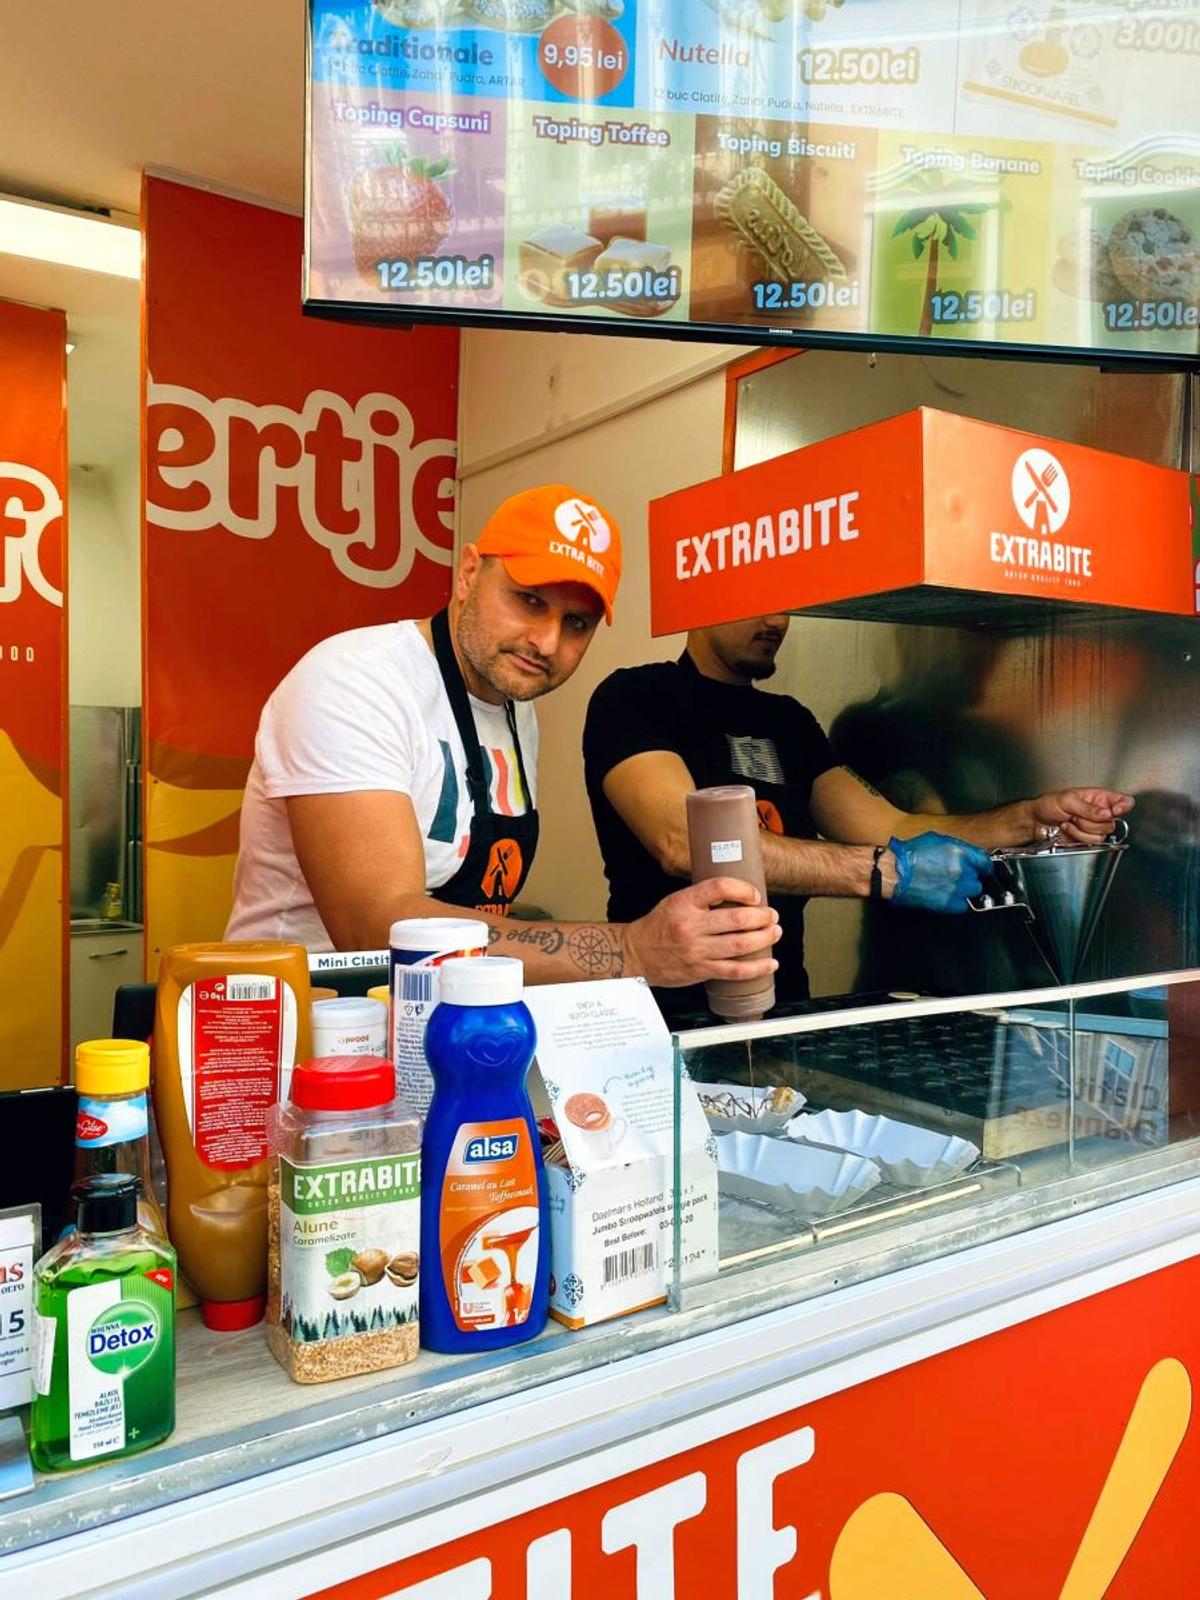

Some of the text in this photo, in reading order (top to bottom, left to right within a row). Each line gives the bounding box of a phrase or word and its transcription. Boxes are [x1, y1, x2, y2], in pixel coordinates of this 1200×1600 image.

[331, 34, 493, 66] Traditionale
[544, 43, 624, 71] 9,95 lei
[659, 39, 750, 68] Nutella
[800, 47, 916, 83] 12.50lei
[666, 89, 688, 101] buc
[333, 102, 490, 133] Toping Capsuni
[534, 119, 670, 145] Toping Toffee
[717, 134, 856, 160] Toping Biscuiti
[901, 147, 1040, 176] Toping Banane
[1075, 160, 1137, 184] Toping
[377, 258, 490, 288] 12.50lei
[568, 270, 678, 299] 12.50lei
[753, 281, 859, 309] 12.50lei
[931, 293, 1035, 321] 12.50lei
[1106, 301, 1200, 328] 12.50le
[676, 491, 859, 580] EXTRABITE
[990, 532, 1092, 577] EXTRABITE
[318, 957, 347, 968] Mini
[470, 1137, 514, 1158] alsa
[293, 1220, 339, 1234] Alune
[293, 1231, 357, 1246] Caramelizate
[592, 1221, 617, 1235] Jumbo
[604, 1237, 620, 1248] Best
[90, 1324, 154, 1354] Detox
